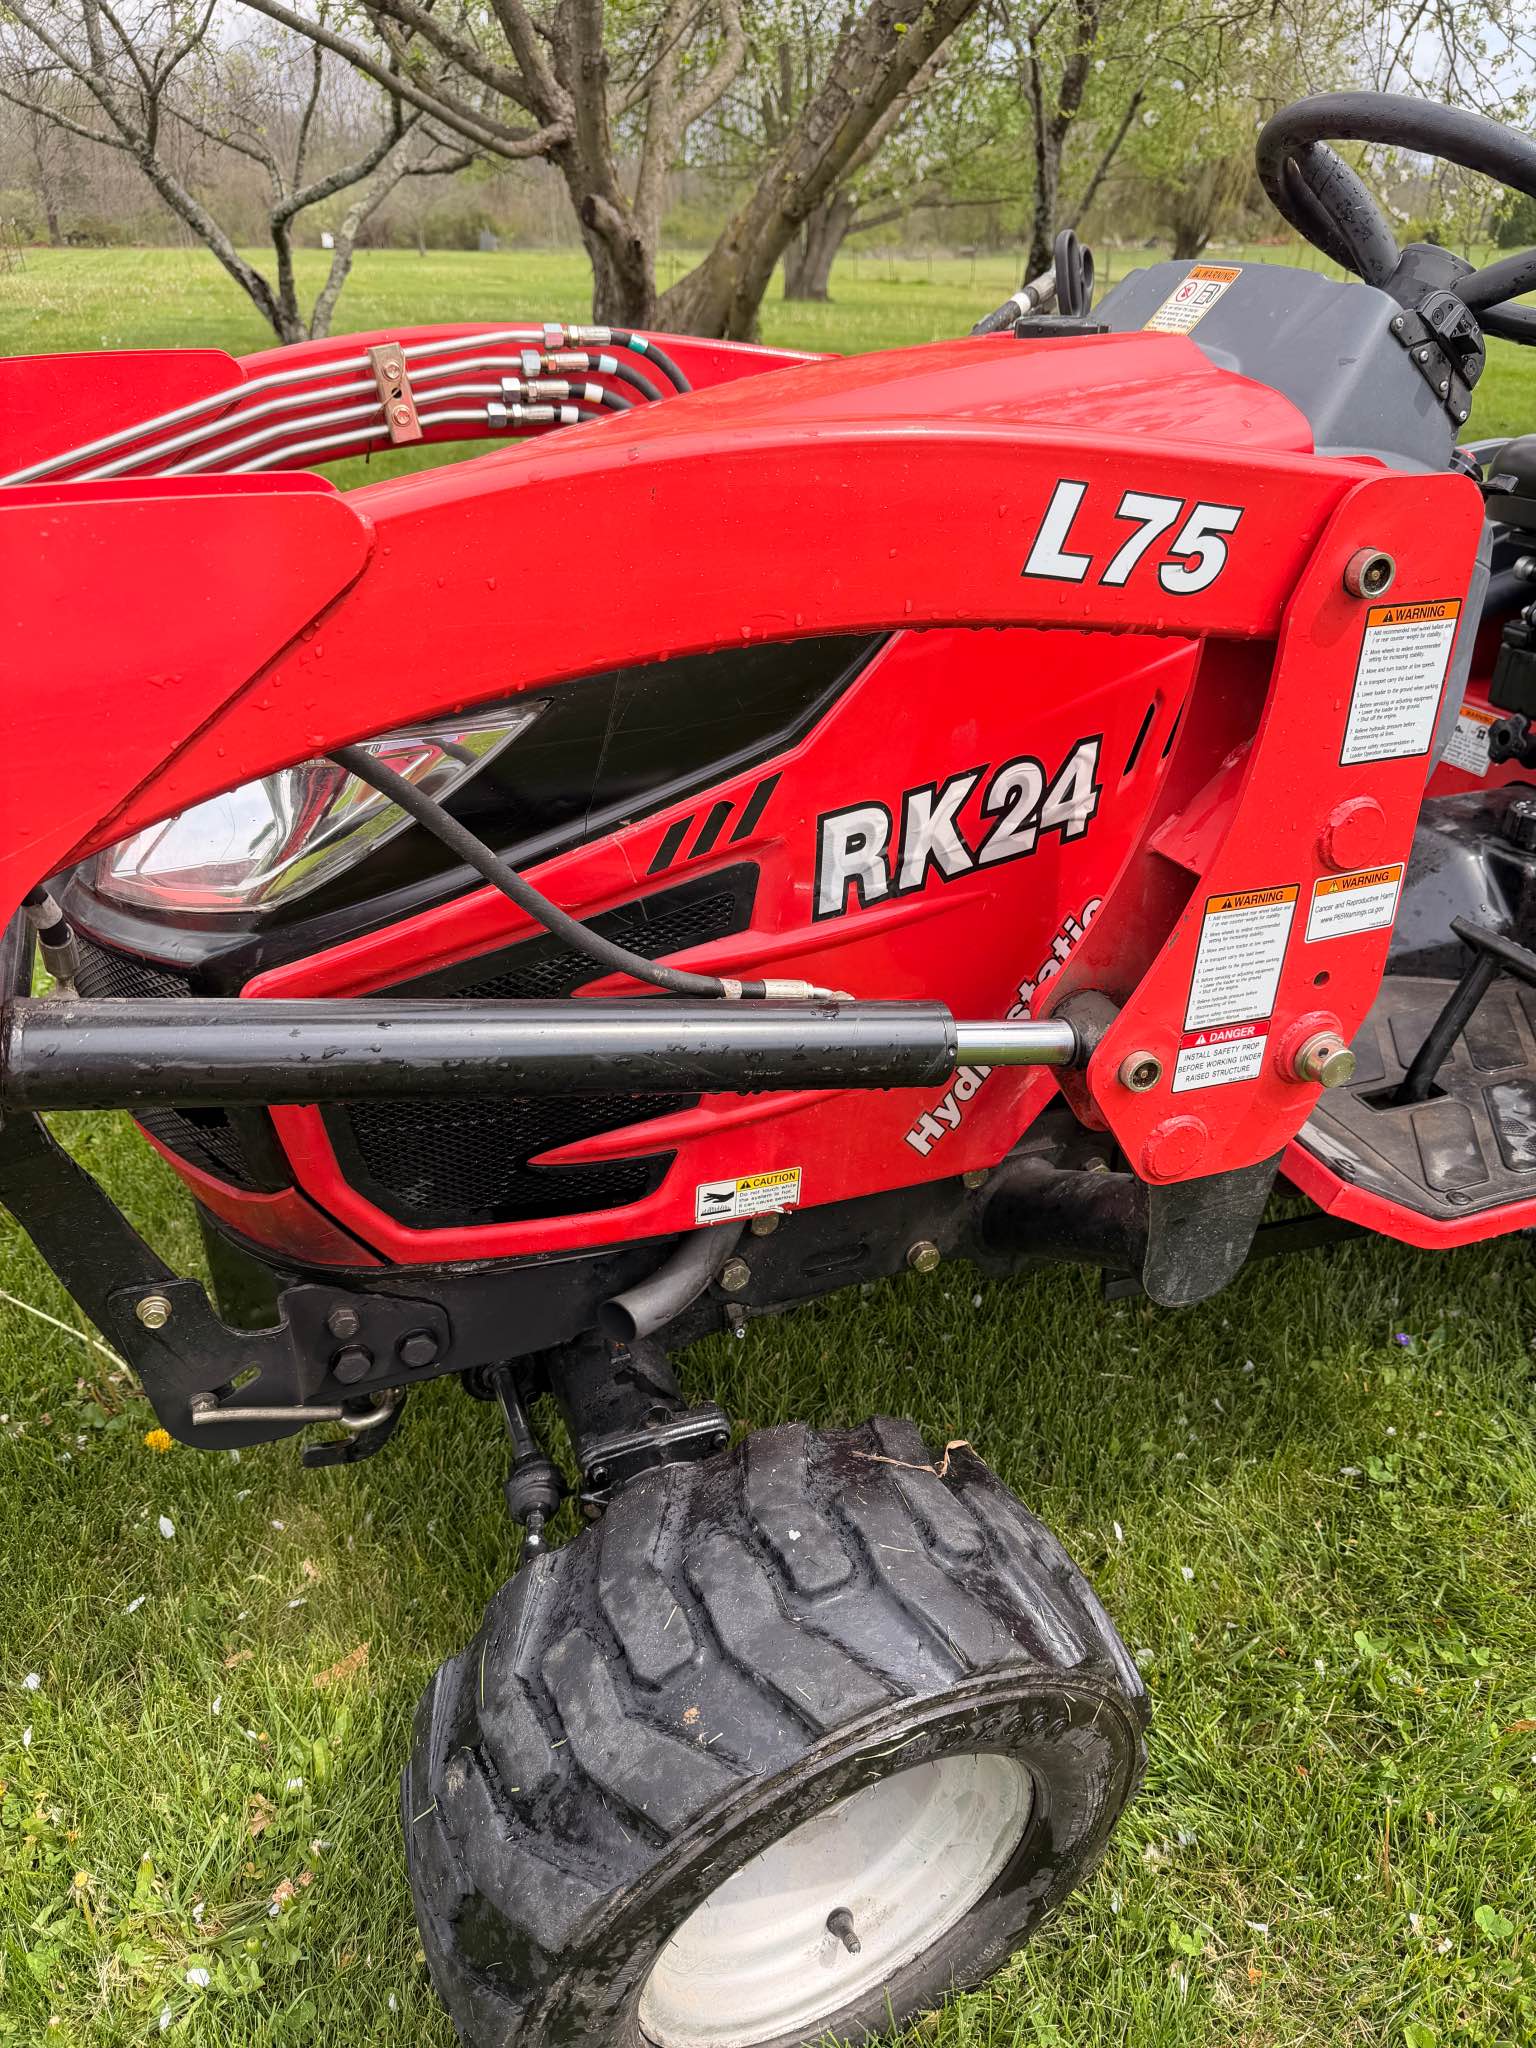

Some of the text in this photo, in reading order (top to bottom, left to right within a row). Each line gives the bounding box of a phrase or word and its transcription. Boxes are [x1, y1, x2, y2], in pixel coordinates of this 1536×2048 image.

[1201, 269, 1235, 281] WARNING
[1394, 605, 1445, 620] WARNING
[812, 733, 1104, 923] RK24
[1341, 871, 1389, 888] WARNING
[1233, 890, 1284, 907] WARNING
[1314, 891, 1394, 913] Cancer and Reproductive Harm
[1209, 1026, 1255, 1042] DANGER
[1183, 1041, 1259, 1061] INSTALL SAFETY PROP
[1177, 1052, 1261, 1073] BEFORE WORKING UNDER
[1185, 1071, 1209, 1082] RAISED
[1211, 1064, 1250, 1077] STRUCTURE
[753, 1172, 795, 1186] CAUTION
